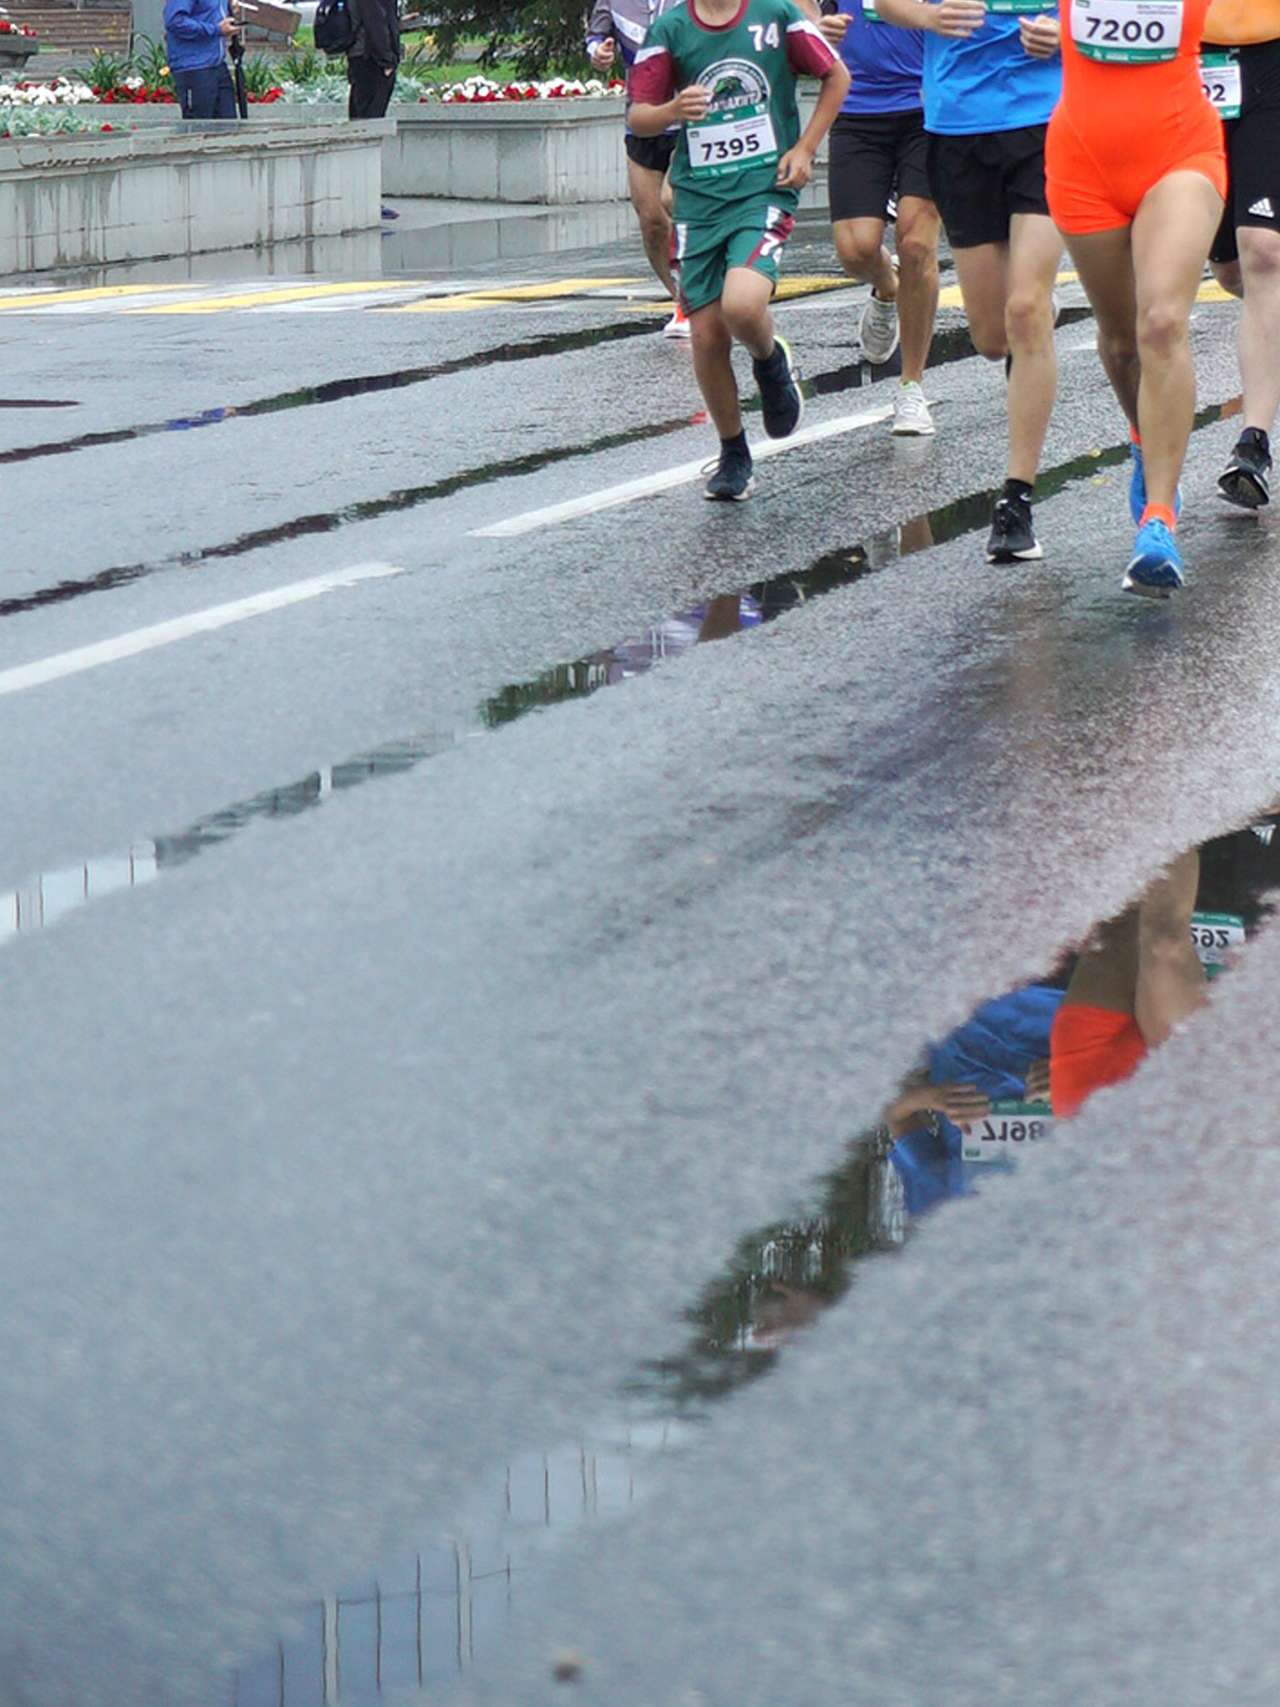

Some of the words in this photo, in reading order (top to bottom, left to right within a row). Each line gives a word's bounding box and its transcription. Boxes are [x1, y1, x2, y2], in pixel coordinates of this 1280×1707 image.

[747, 22, 780, 51] 74
[1086, 16, 1165, 43] 7200
[701, 134, 760, 162] 7395
